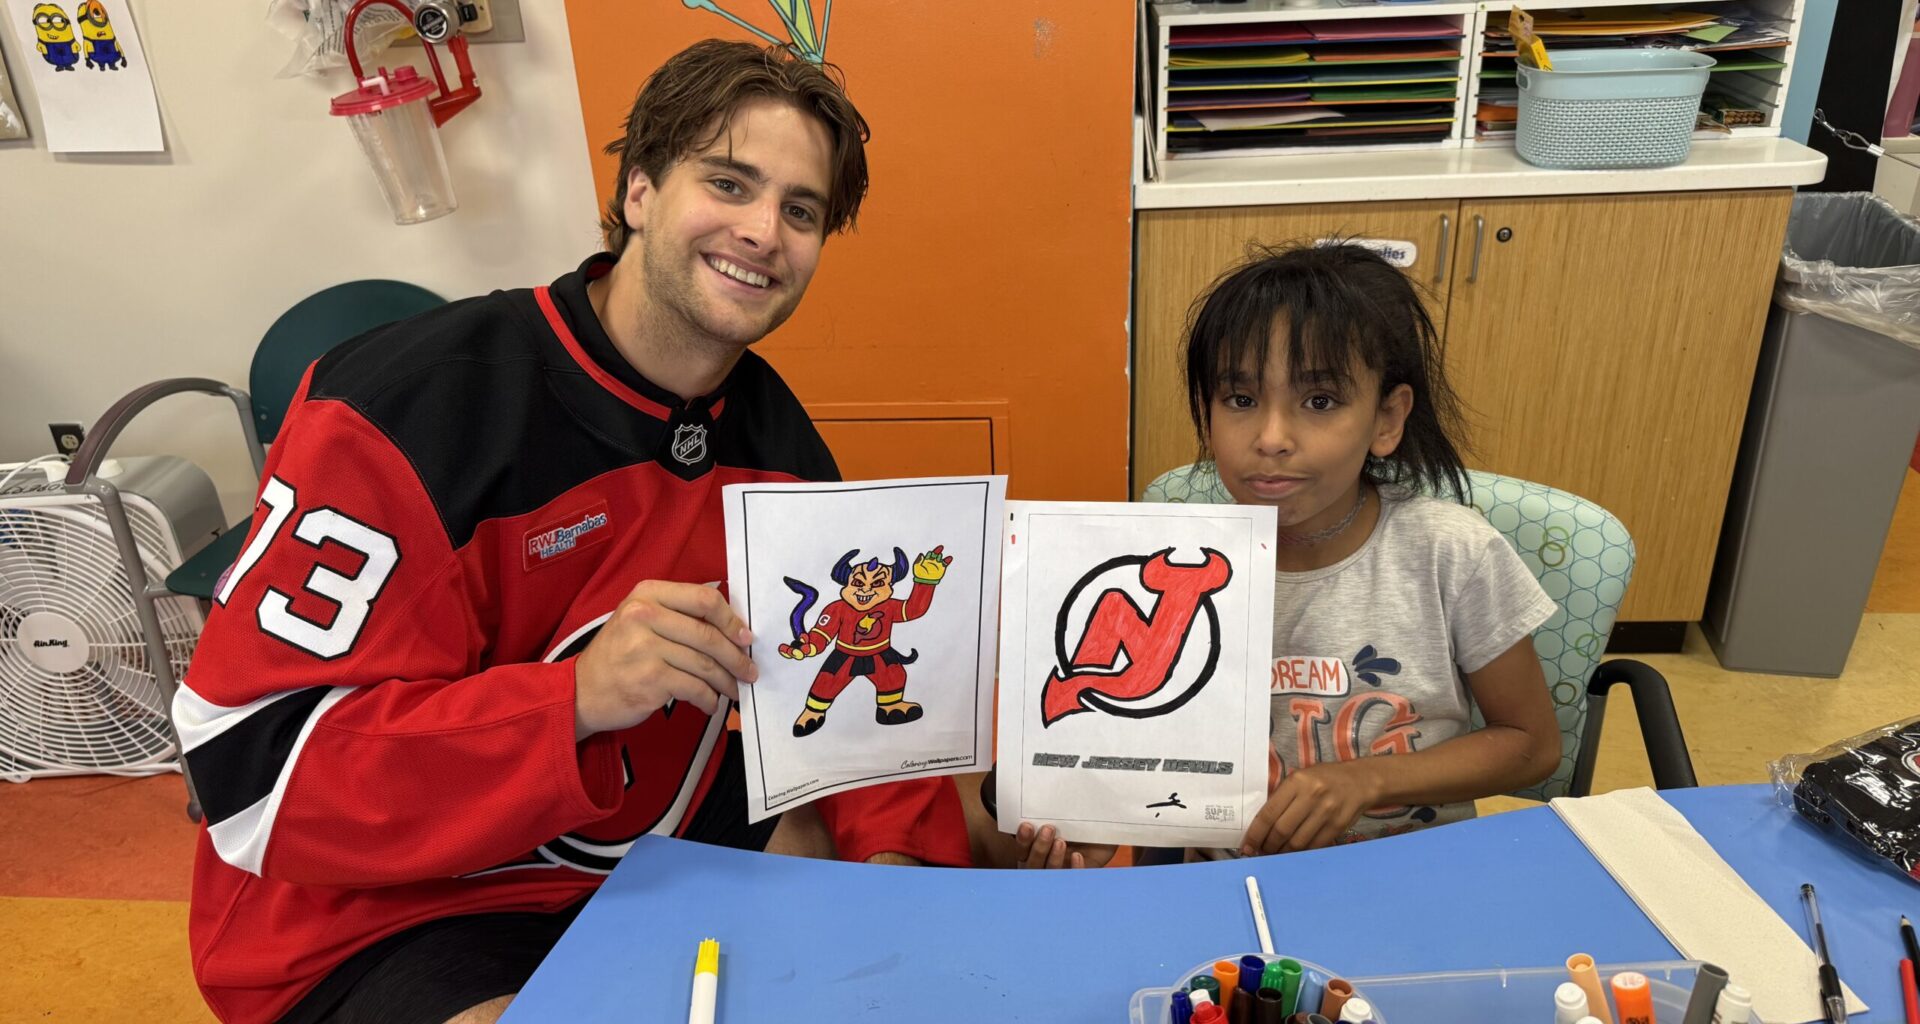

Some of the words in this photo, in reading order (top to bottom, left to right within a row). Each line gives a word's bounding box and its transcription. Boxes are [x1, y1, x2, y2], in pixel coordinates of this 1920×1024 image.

[680, 435, 700, 455] NHL
[540, 538, 576, 559] HEALTH
[213, 474, 402, 662] 73
[1032, 752, 1081, 768] NEW
[1081, 755, 1162, 772] JERSEY
[1162, 758, 1234, 775] DEVILS
